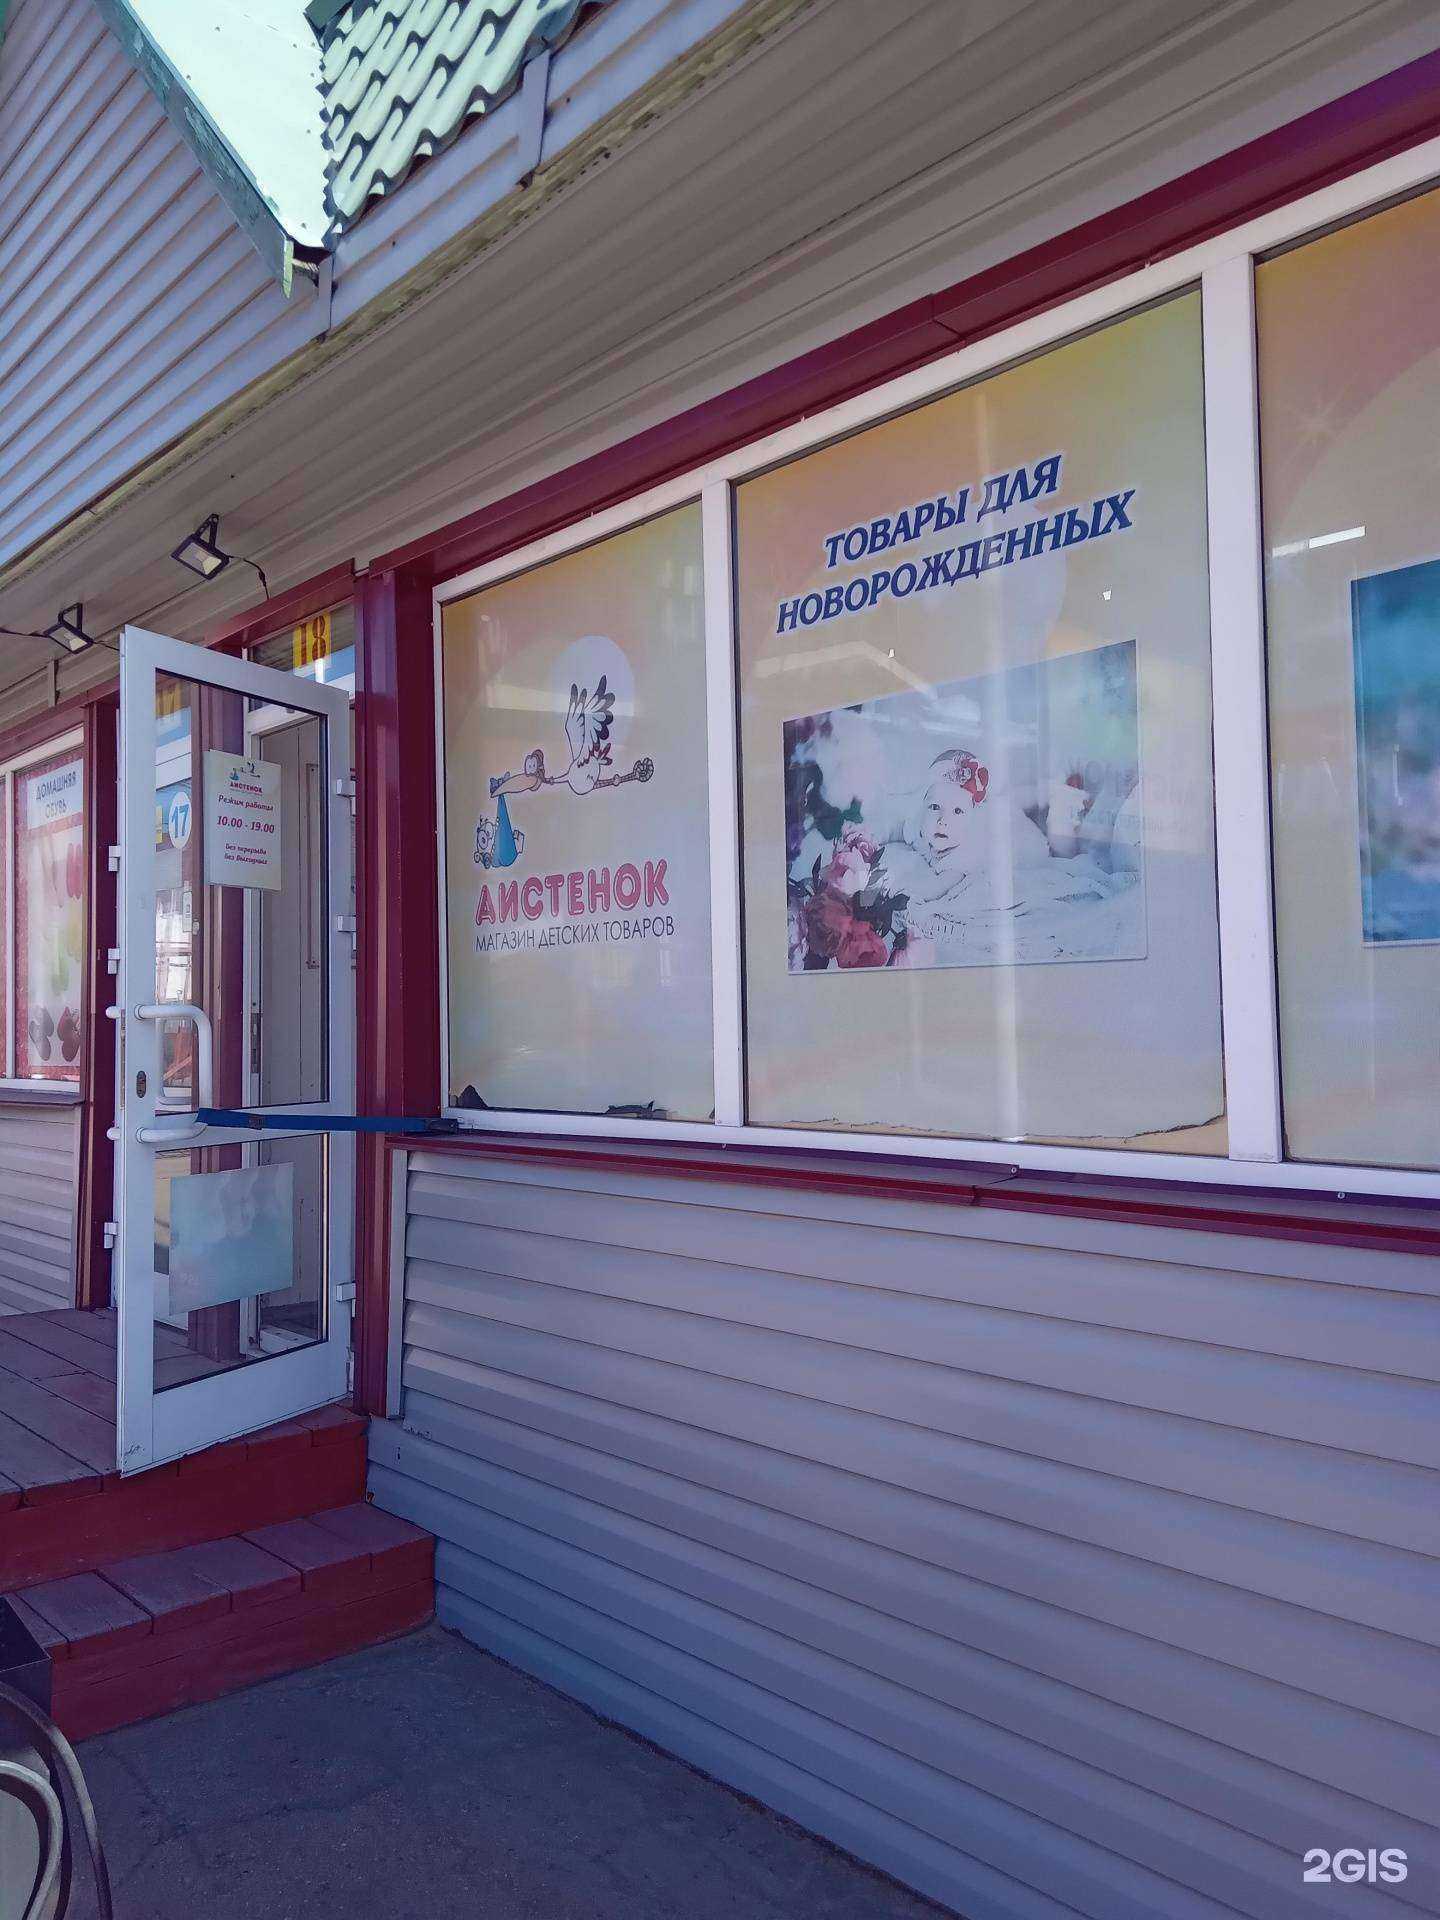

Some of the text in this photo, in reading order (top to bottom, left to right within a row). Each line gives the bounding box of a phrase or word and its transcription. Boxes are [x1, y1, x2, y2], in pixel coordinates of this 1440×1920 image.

[825, 454, 1062, 568] ТОВАРЫ ДЛЯ
[776, 489, 1136, 633] НОВОРОЖДЕННЫХ
[219, 794, 273, 811] Режим работы
[230, 781, 263, 793] АИСТЕНОК
[171, 803, 190, 839] 17
[217, 815, 243, 828] 10.00
[251, 821, 275, 833] 19.00
[475, 859, 670, 926] АИСТЕНОК
[475, 916, 675, 952] МАГАЗИН ДЕТСКИХ ТОВАРОВ
